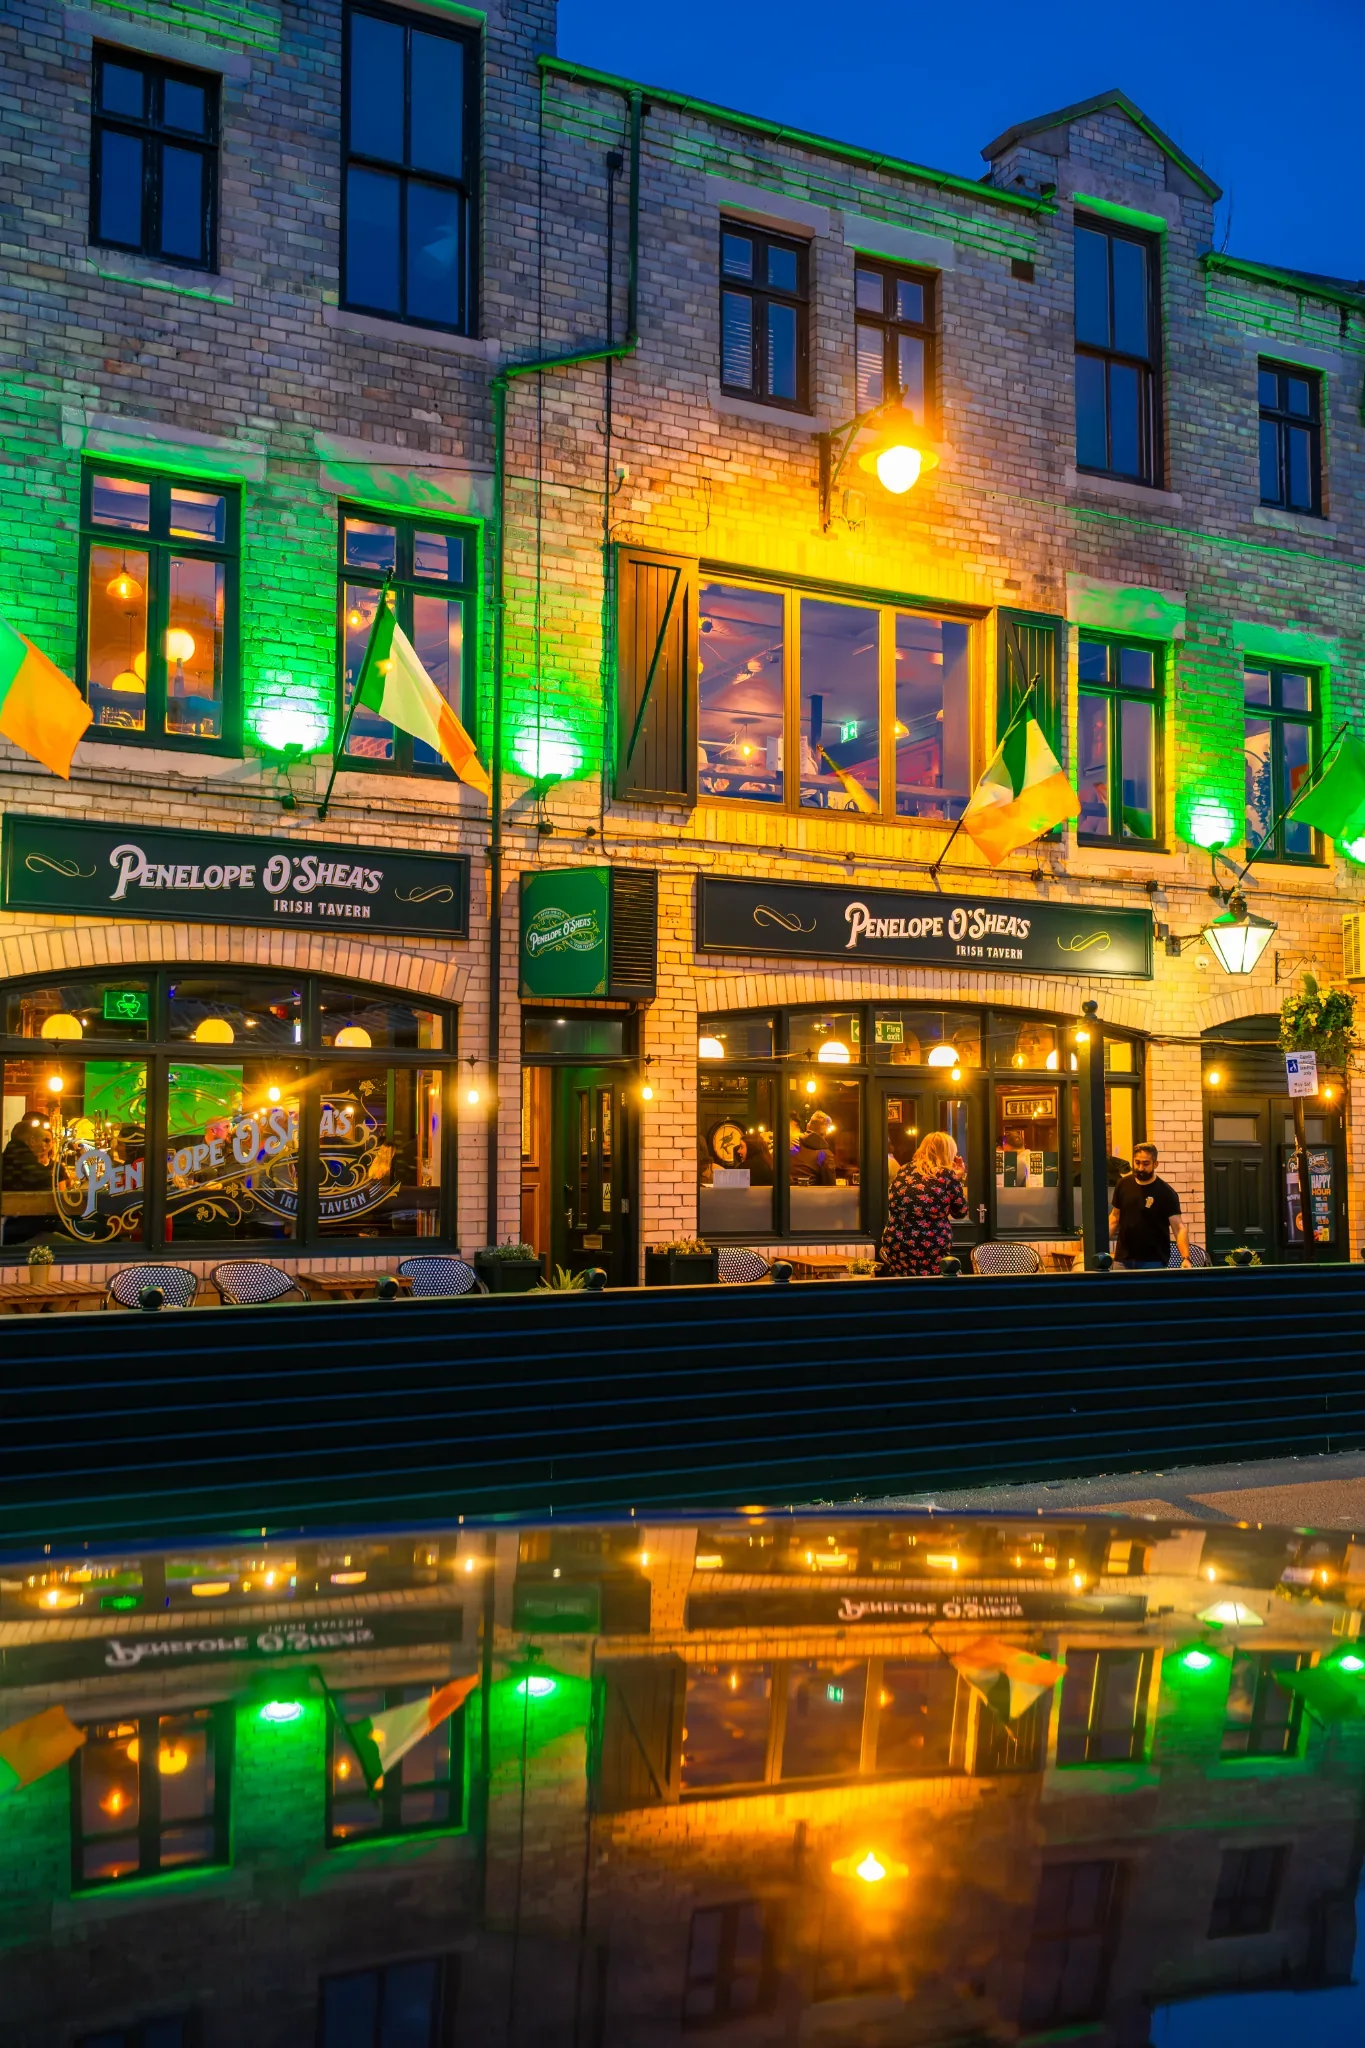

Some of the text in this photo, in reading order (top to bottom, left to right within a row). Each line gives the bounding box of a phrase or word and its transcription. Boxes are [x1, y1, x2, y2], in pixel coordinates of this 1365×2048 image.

[109, 843, 384, 900] PENELOPE O'SHEA'S
[273, 899, 371, 919] IRISH TAVERN
[844, 902, 1031, 949] PENELOPE O'SHEA'S
[530, 928, 562, 951] PENELOPE
[956, 945, 1023, 960] IRISH TAVERN
[886, 1025, 901, 1033] Fire
[886, 1033, 901, 1041] exit
[1310, 1174, 1331, 1189] HAPPY
[279, 1192, 366, 1214] IRI TAVERN
